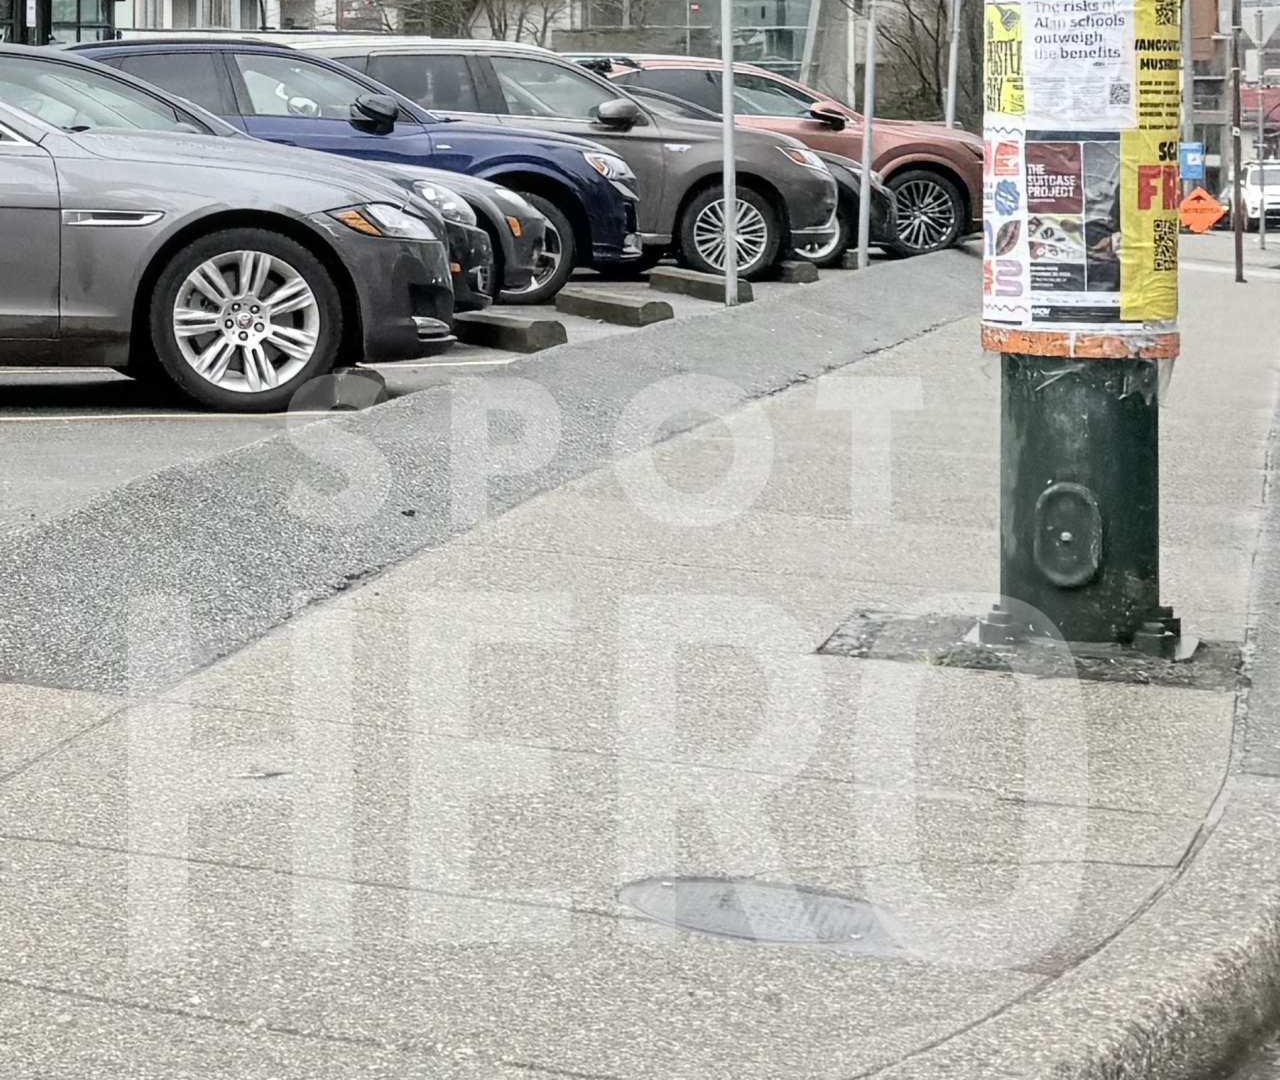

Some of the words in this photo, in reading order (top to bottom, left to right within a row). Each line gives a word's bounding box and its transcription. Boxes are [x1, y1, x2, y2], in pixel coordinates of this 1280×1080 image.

[1063, 0, 1099, 13] risks
[1070, 14, 1126, 27] schools
[1034, 30, 1104, 46] outweigh
[1027, 163, 1045, 175] THE
[1027, 175, 1076, 187] SUITCASE
[1027, 186, 1075, 198] PROJECT
